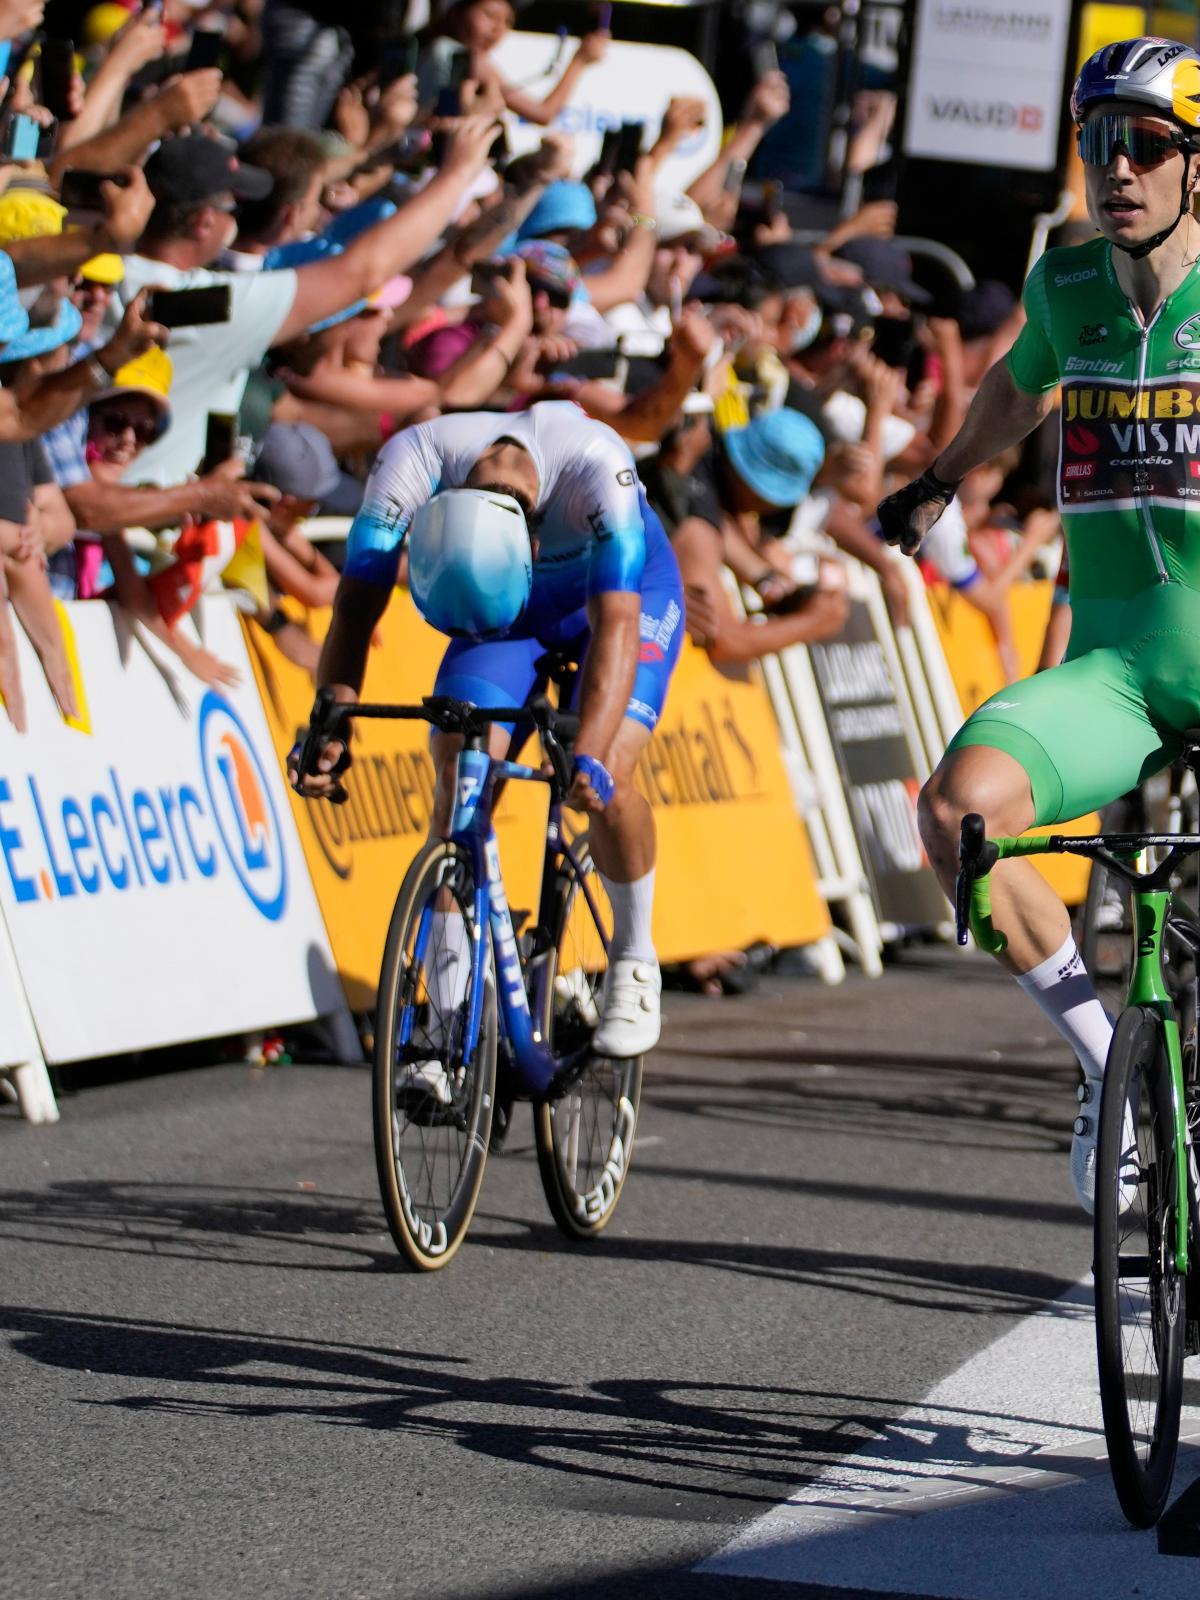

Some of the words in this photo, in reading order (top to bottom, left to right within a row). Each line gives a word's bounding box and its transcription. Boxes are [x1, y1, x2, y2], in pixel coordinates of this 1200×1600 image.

[930, 98, 1018, 131] VAUD
[1054, 267, 1098, 288] ŠKODA
[1064, 357, 1125, 374] Santini
[1109, 455, 1174, 466] cervélo
[0, 764, 220, 904] E.Leclerc
